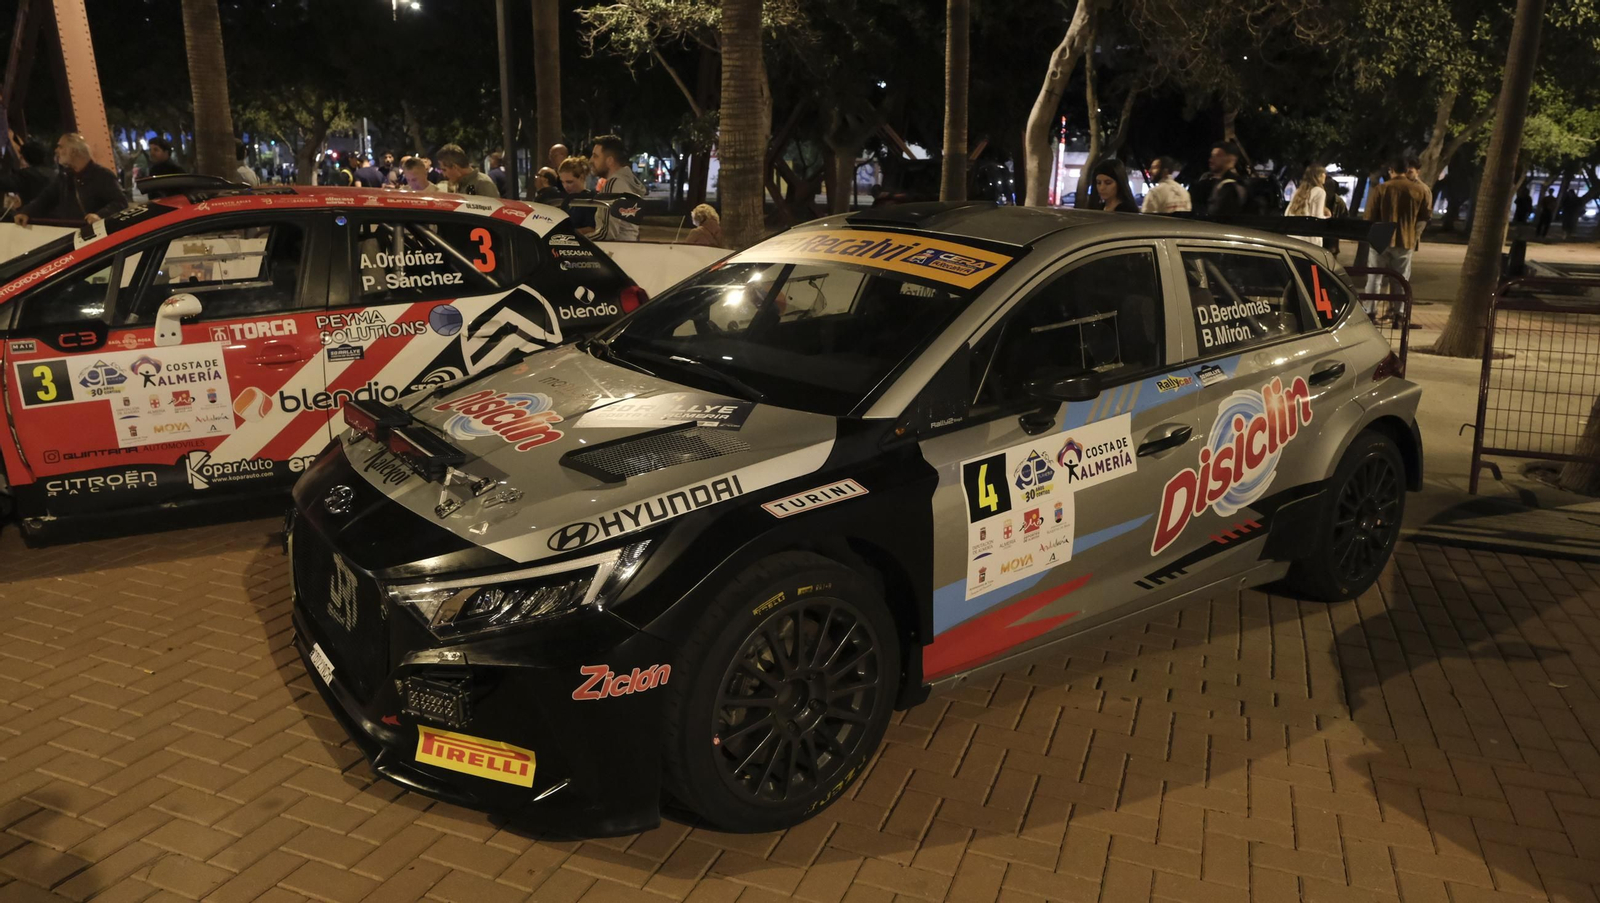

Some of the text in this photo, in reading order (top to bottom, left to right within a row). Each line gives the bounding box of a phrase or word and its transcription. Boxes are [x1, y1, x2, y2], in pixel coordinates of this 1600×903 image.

[470, 227, 496, 273] 3
[798, 234, 922, 263] Recalvi
[386, 271, 464, 290] Sánchez
[1310, 264, 1333, 320] 4
[315, 310, 386, 330] PEYMA
[559, 302, 618, 321] blendio
[58, 331, 98, 348] C3
[230, 318, 298, 342] TORCA
[319, 320, 428, 346] SOLUTIONS
[11, 342, 35, 352] MAIK
[166, 358, 219, 371] COSTA DE
[32, 365, 58, 402] 3
[157, 368, 222, 388] ALMERÍA
[90, 387, 103, 398] 30
[279, 381, 400, 413] blendio
[431, 388, 565, 453] Disiclin
[142, 440, 206, 453] AUTOMOVILES
[1085, 436, 1129, 459] COSTA DE
[211, 471, 274, 484] www.koparauto.com
[1080, 450, 1133, 481] ALMERÍA
[1150, 375, 1314, 557] Disiclin
[46, 469, 158, 492] CITROËN
[978, 463, 999, 512] 4
[599, 474, 744, 538] HYUNDAI
[773, 483, 857, 513] TURINI
[1025, 488, 1036, 503] 30
[571, 663, 672, 701] Ziclón
[420, 731, 532, 777] PIRELLI
